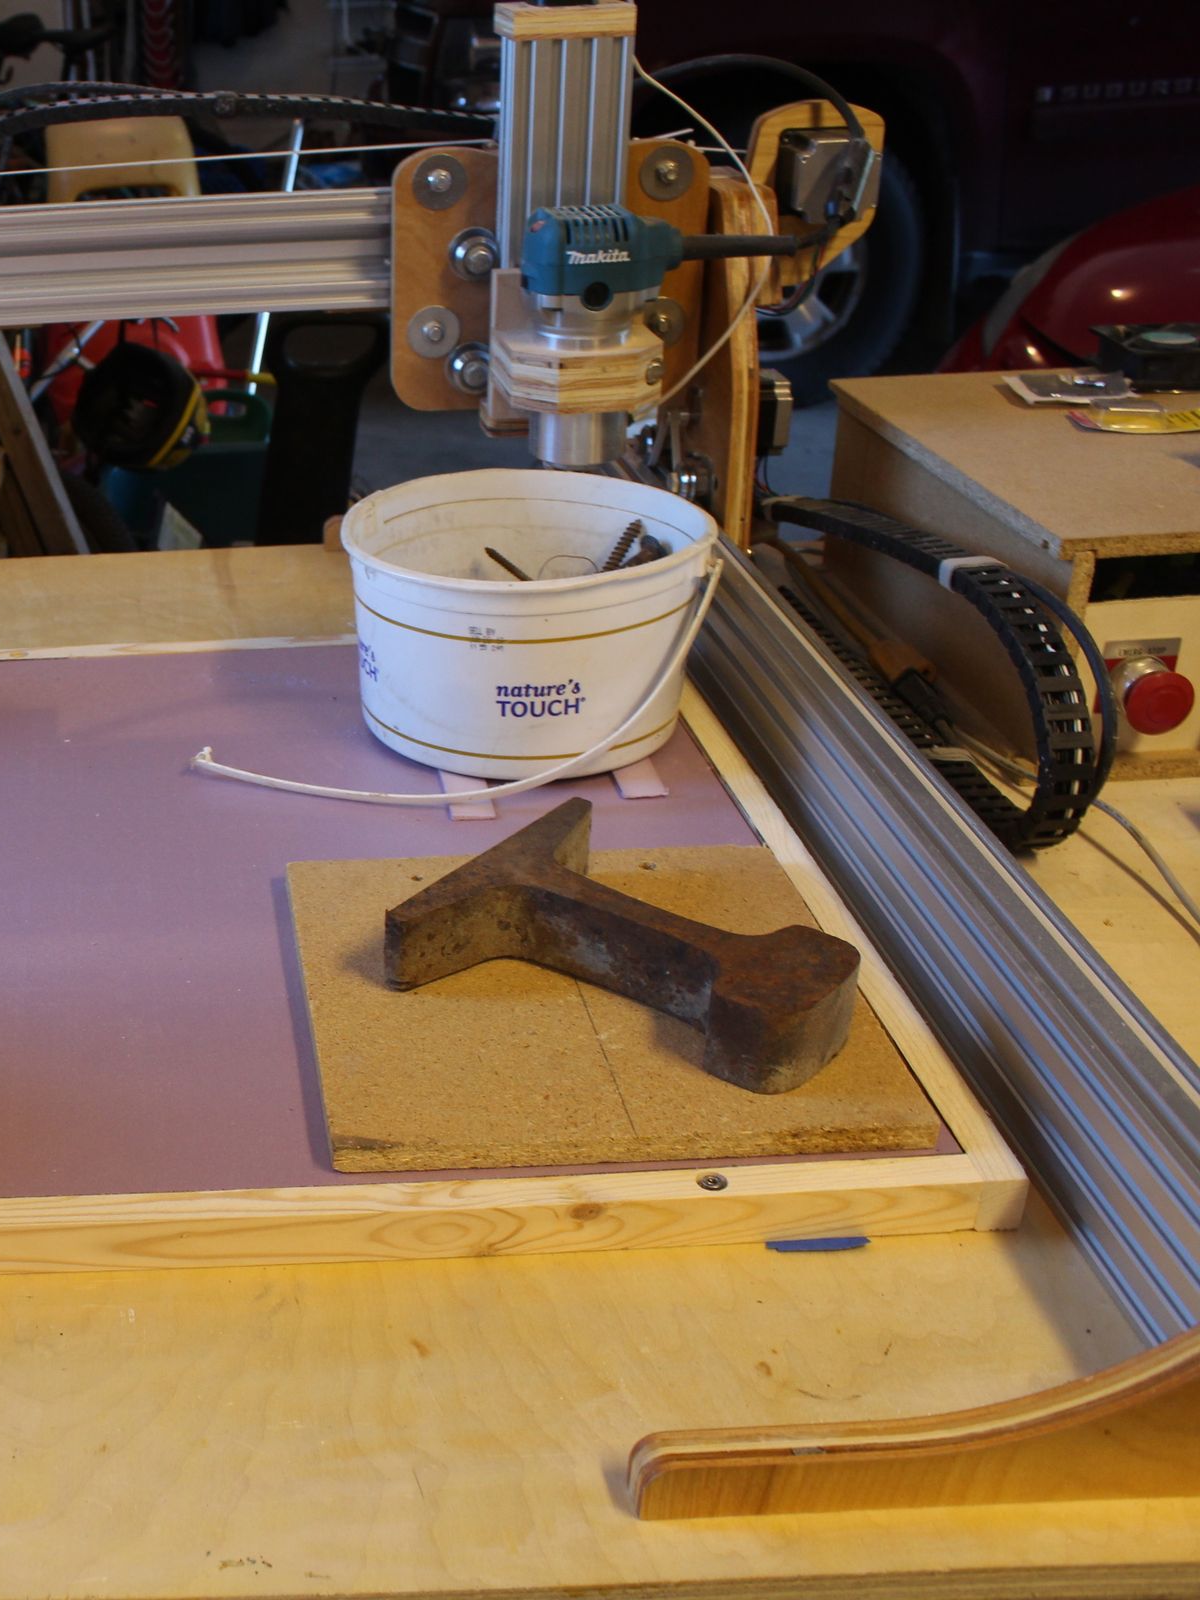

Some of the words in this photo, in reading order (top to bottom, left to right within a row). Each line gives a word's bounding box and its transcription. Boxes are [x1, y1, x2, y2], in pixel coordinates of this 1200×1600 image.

[1059, 77, 1200, 100] SUBURB
[565, 248, 631, 265] Makita
[495, 679, 581, 698] nature's
[495, 698, 581, 718] TOUCH
